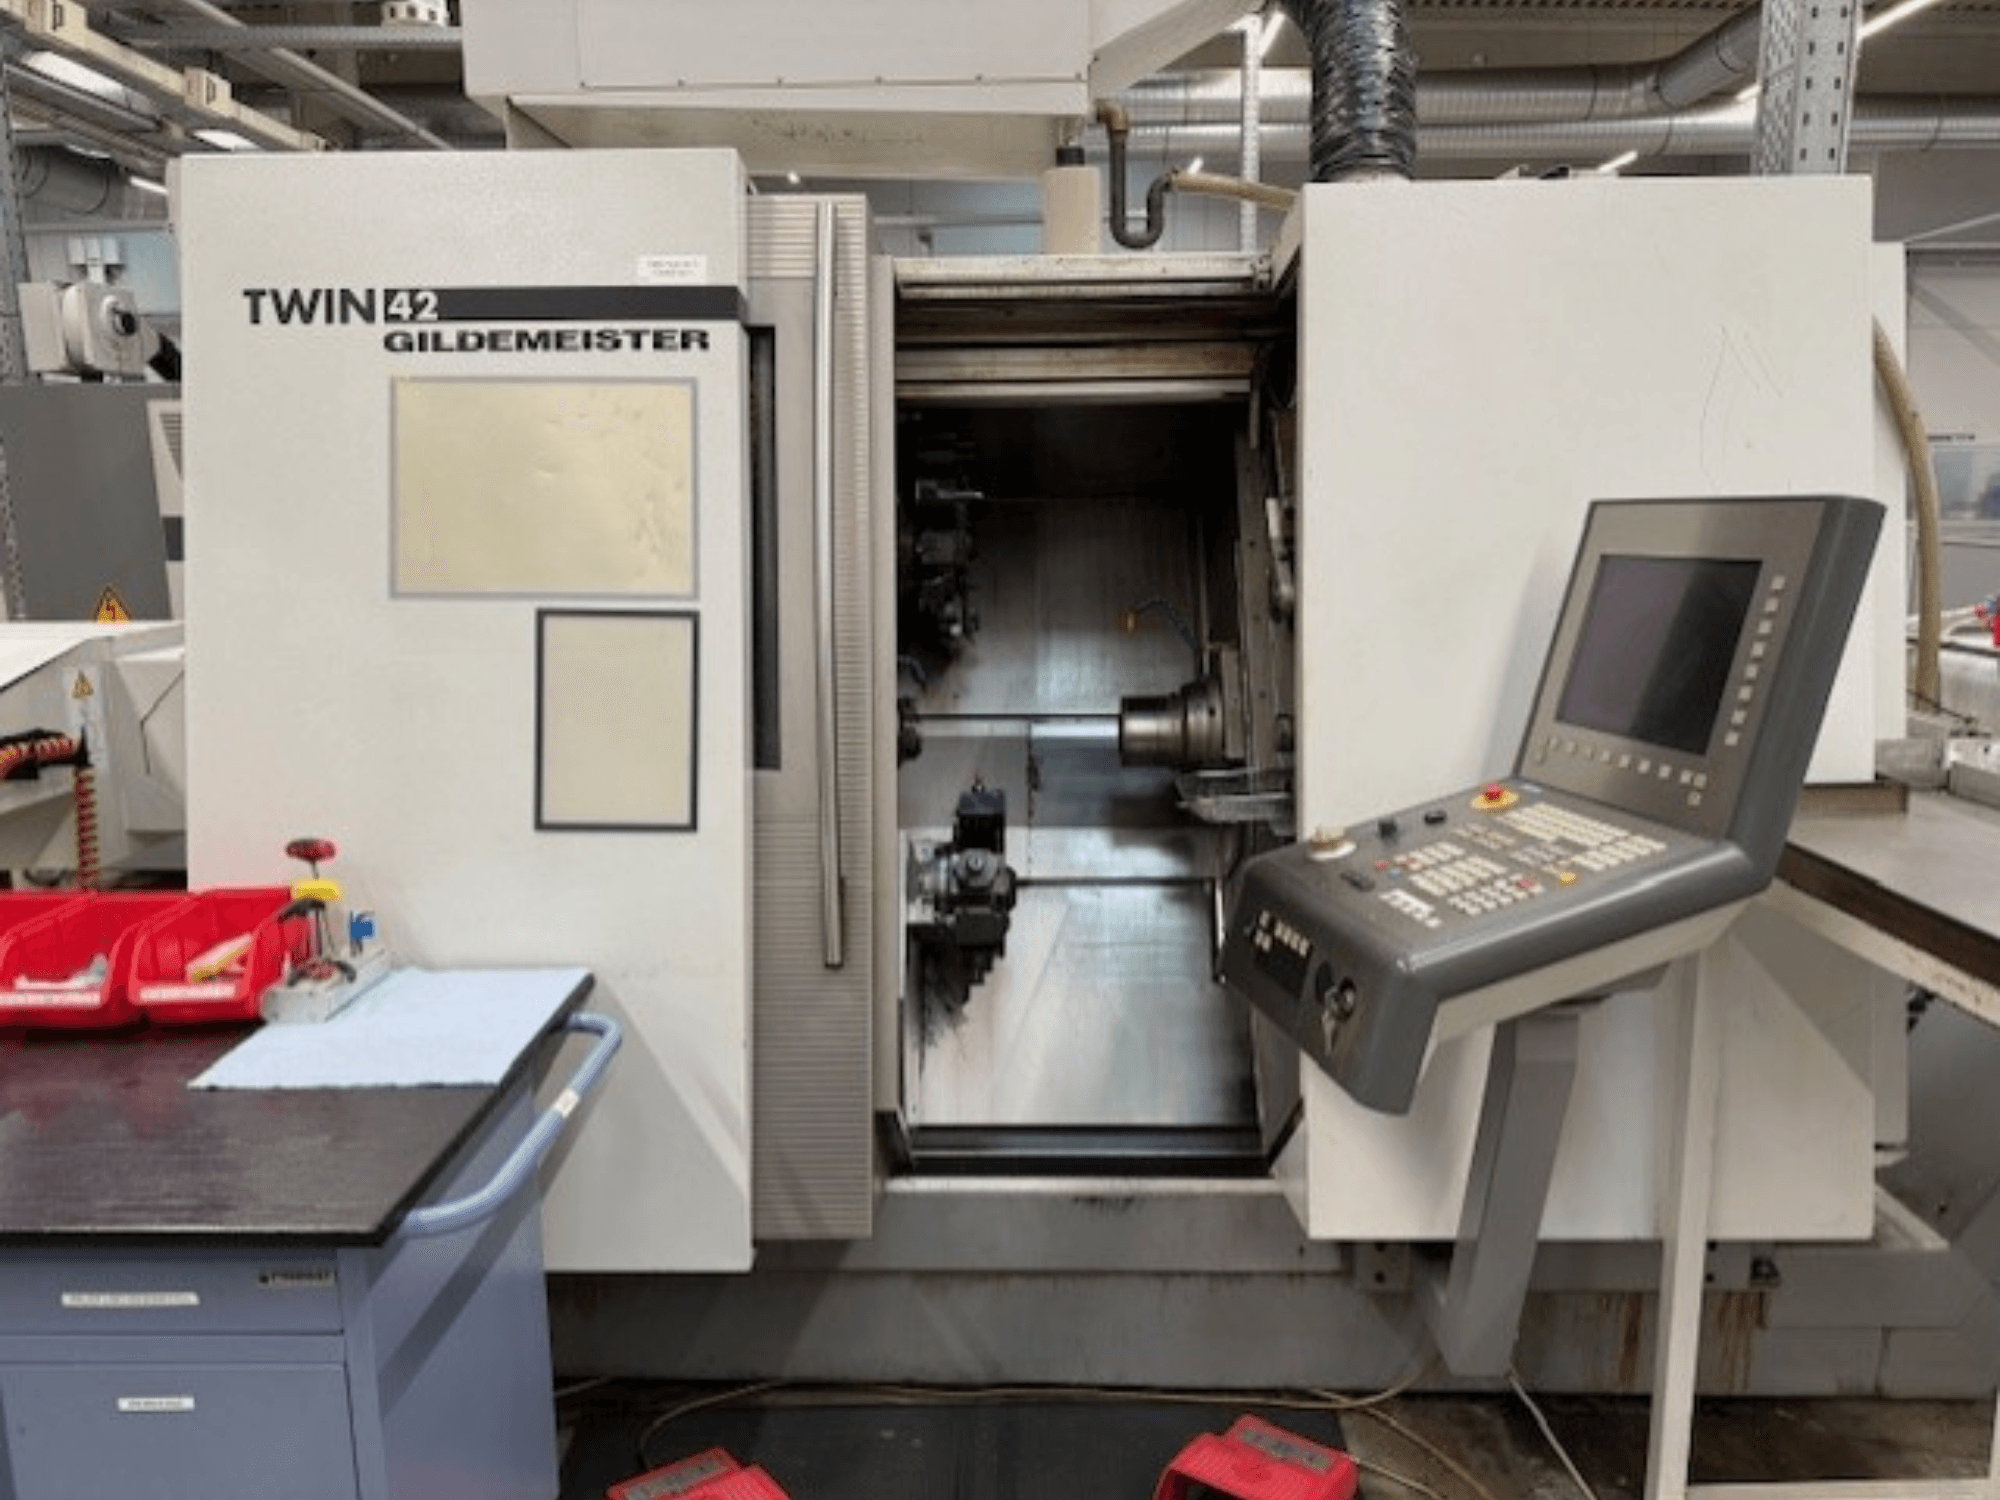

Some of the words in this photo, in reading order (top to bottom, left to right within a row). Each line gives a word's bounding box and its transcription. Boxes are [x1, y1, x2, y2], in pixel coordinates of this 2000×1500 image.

[243, 288, 376, 325] TWIN
[387, 290, 439, 322] 42
[384, 330, 710, 352] GILDEMEISTER
